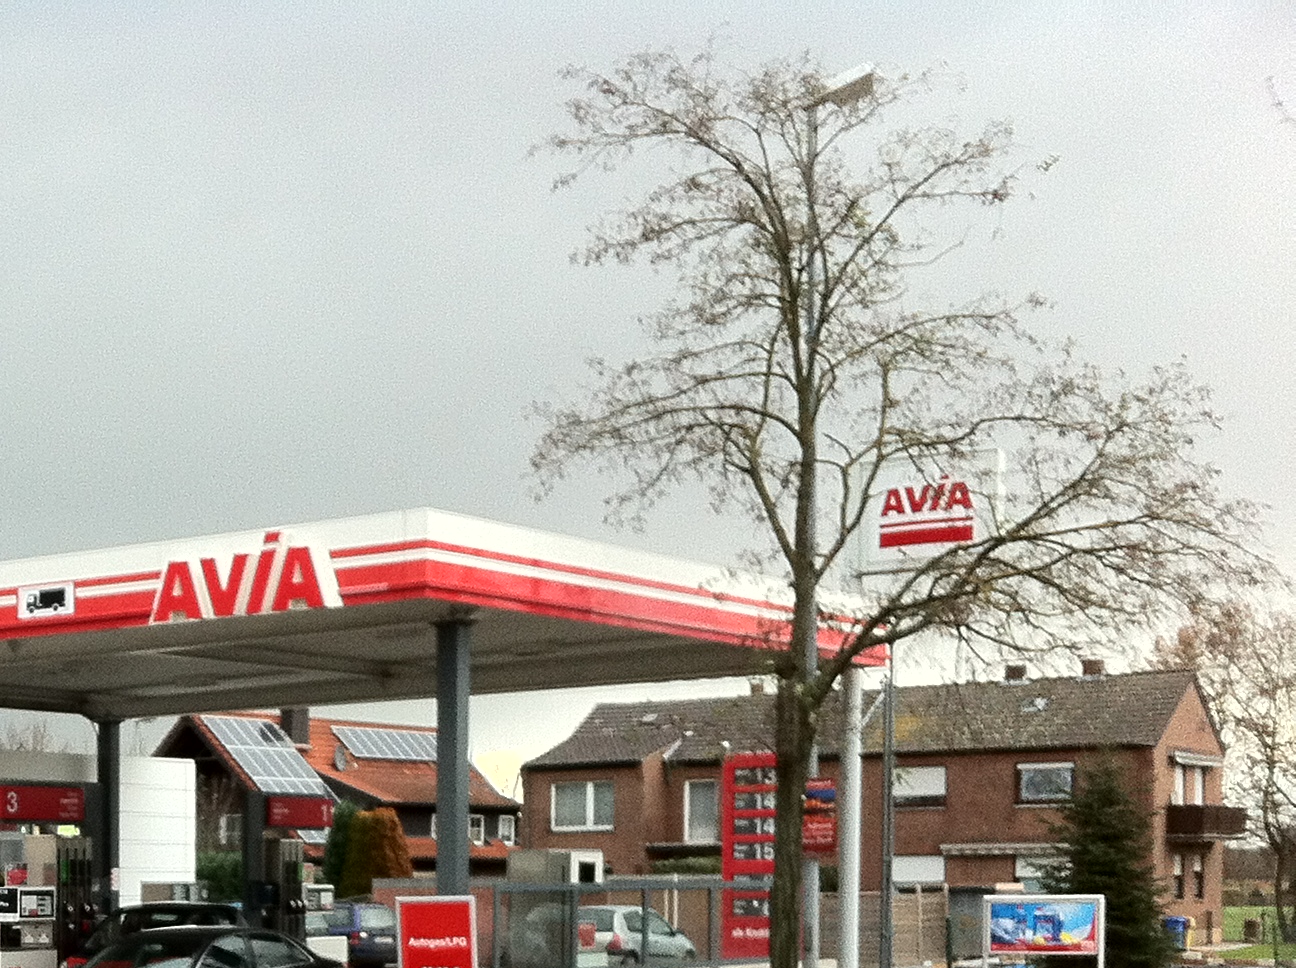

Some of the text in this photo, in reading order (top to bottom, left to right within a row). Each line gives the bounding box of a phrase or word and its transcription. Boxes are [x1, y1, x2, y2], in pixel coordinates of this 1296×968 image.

[881, 474, 973, 517] AVIA
[153, 531, 325, 622] AVIA
[7, 791, 18, 813] 3
[408, 936, 467, 949] Autogas/LPG
